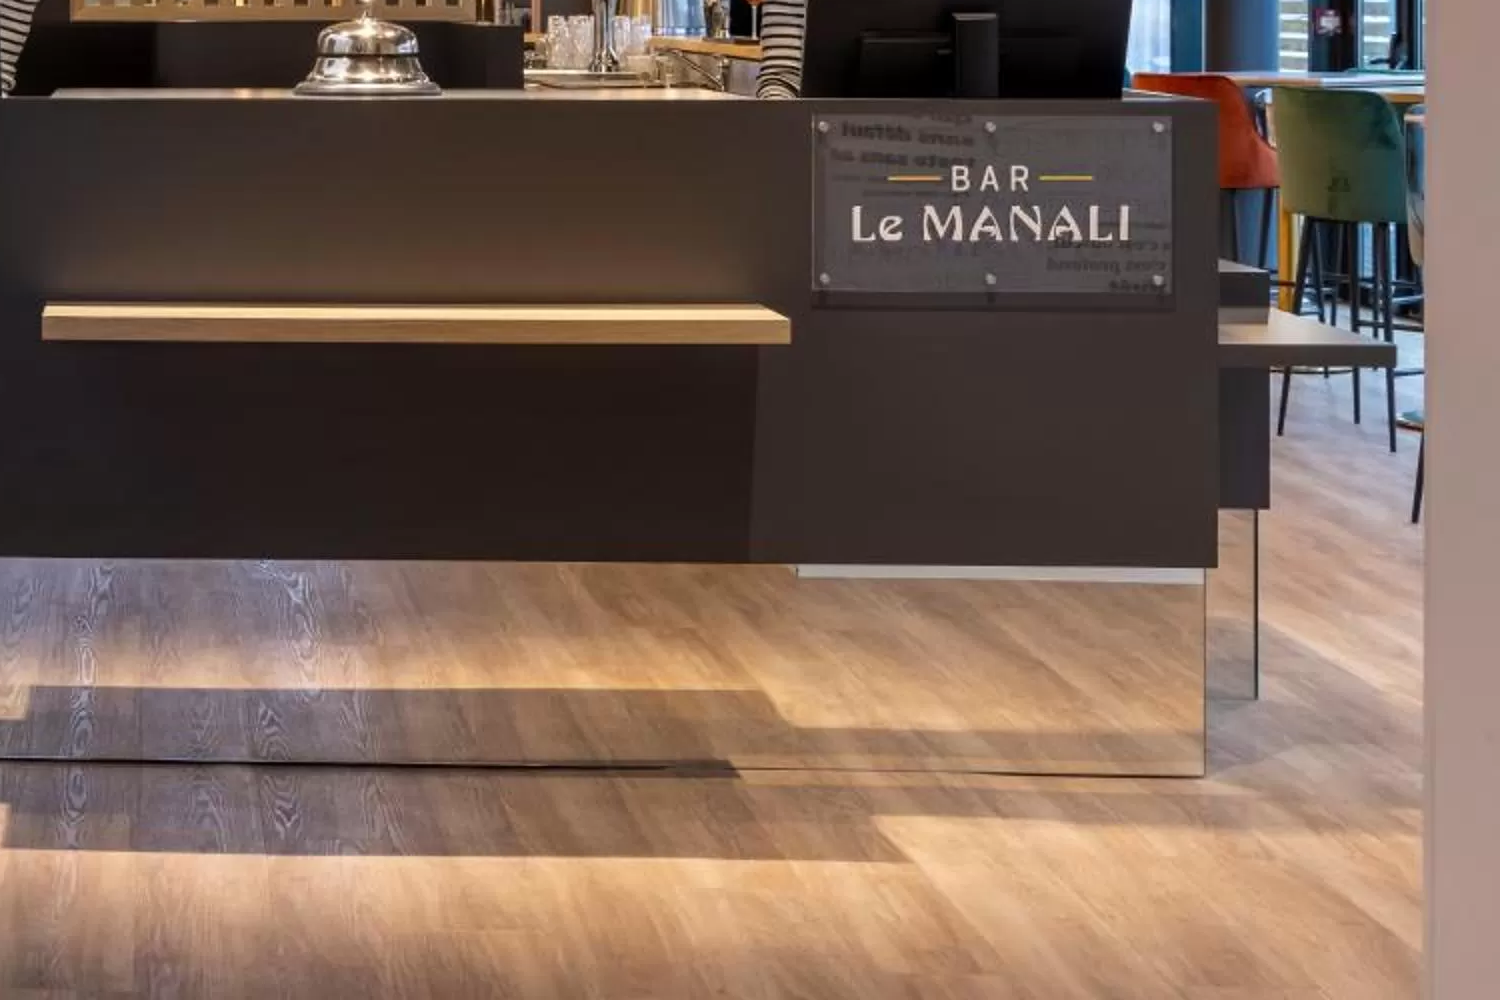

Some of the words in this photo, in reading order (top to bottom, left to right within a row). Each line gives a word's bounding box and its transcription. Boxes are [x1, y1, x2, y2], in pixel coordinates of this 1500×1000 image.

[951, 164, 1030, 192] BAR
[851, 205, 903, 242] Le
[922, 205, 1130, 242] MANALI
